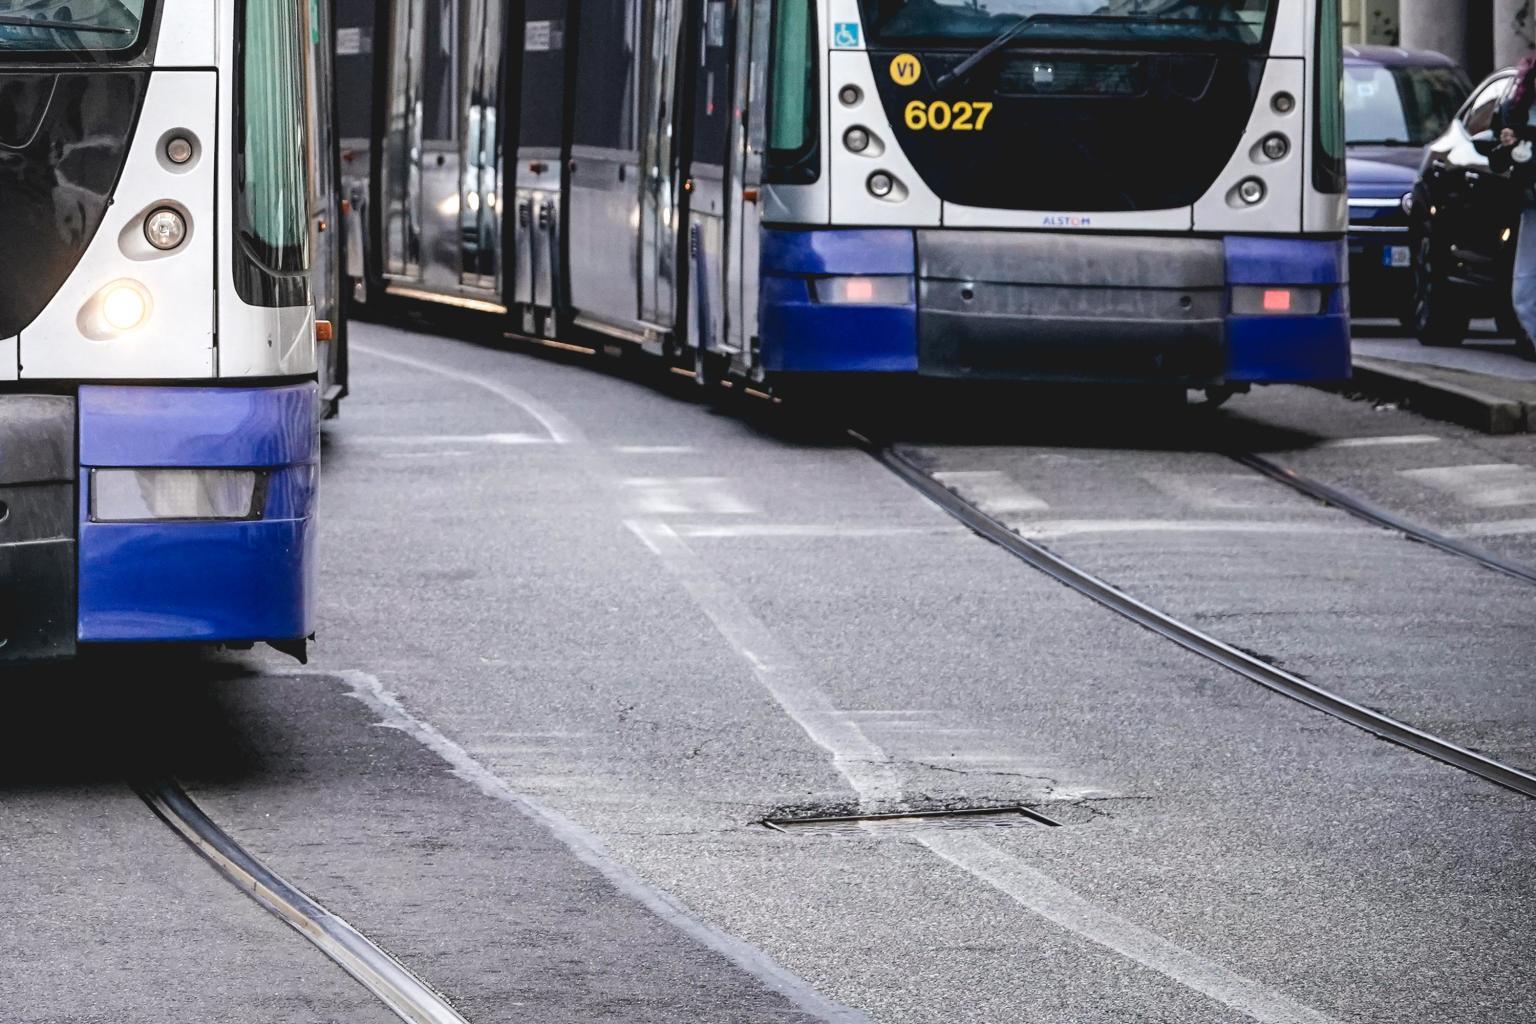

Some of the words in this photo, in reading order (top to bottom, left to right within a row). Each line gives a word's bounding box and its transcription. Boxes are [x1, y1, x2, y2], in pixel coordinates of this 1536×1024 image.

[897, 62, 915, 78] V1
[904, 100, 993, 131] 6027
[1043, 216, 1091, 225] ALSTOM
